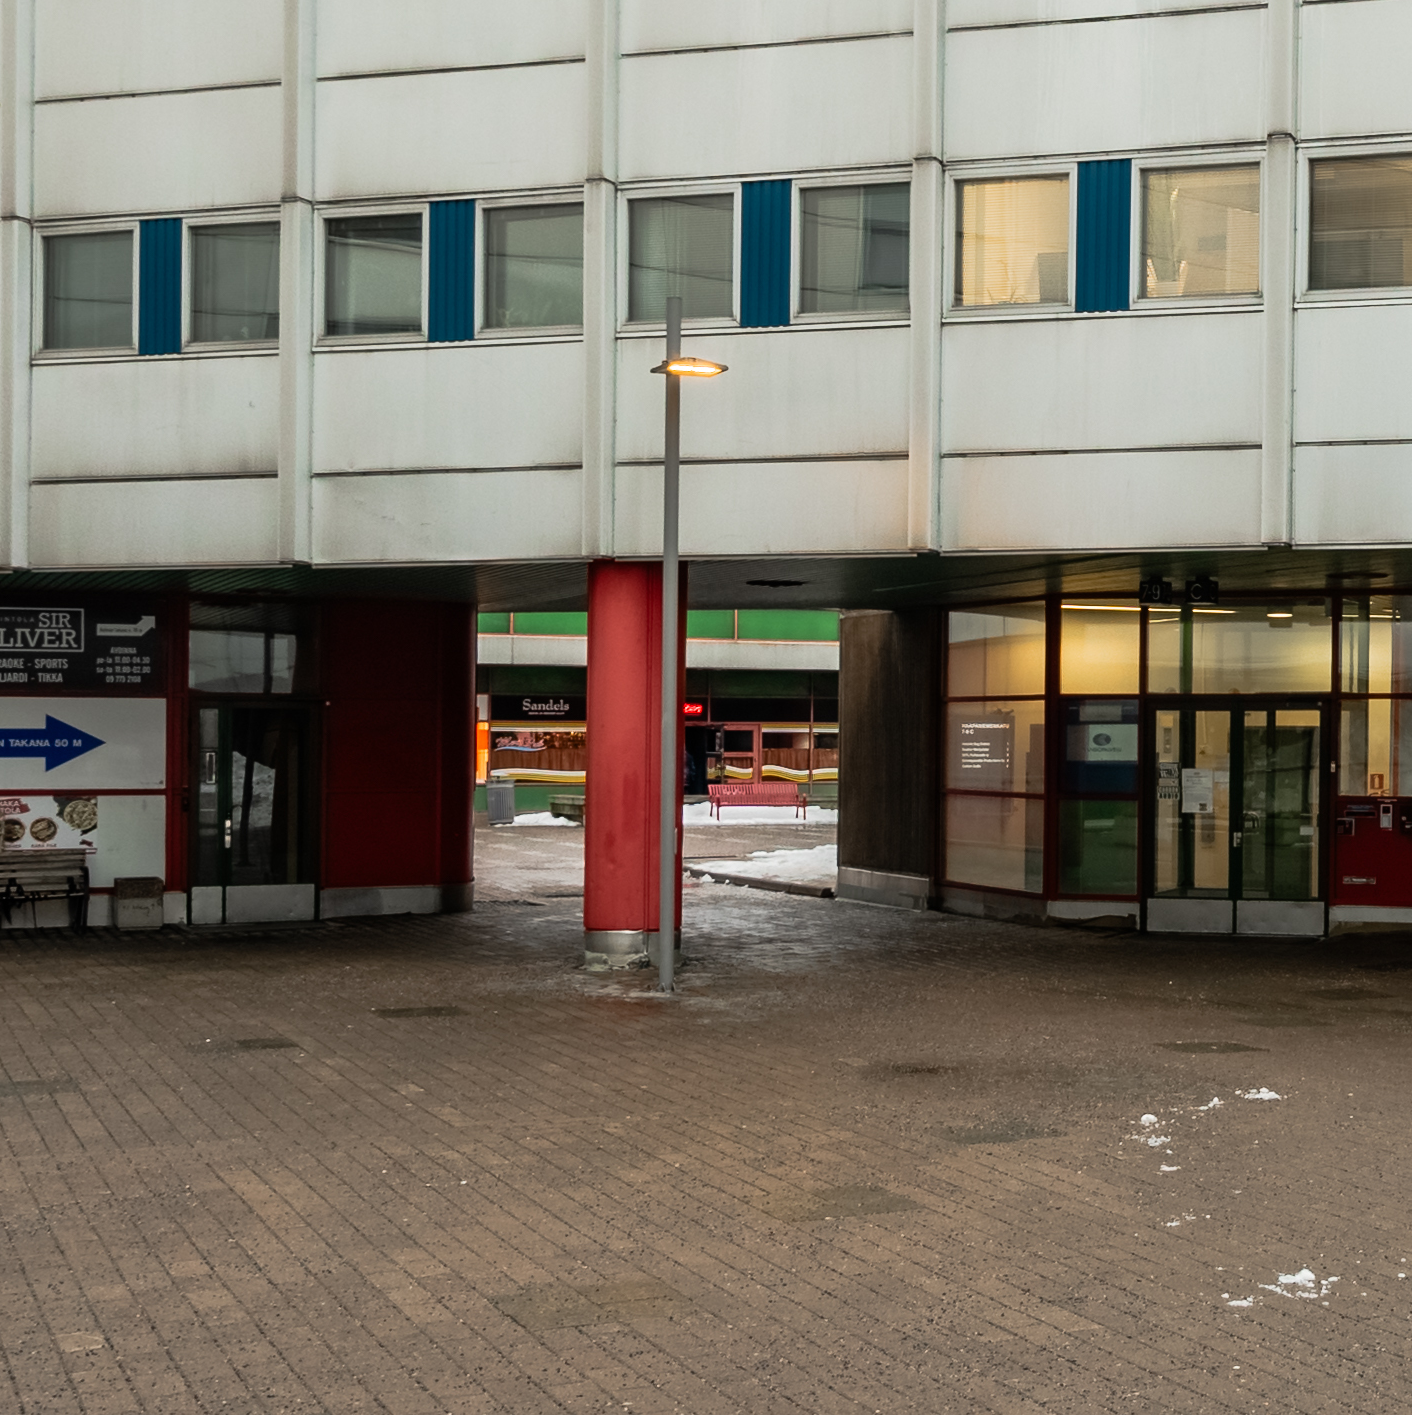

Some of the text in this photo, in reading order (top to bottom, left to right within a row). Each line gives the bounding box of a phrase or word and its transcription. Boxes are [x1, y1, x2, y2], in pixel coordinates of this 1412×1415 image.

[1141, 584, 1161, 600] 7-9
[1190, 583, 1203, 600] C
[38, 612, 72, 628] SIR
[34, 658, 69, 669] SPORTS
[37, 672, 64, 683] TIKKA
[522, 698, 570, 711] Sandels
[9, 739, 50, 748] TAKANA
[54, 739, 69, 748] 50
[72, 739, 82, 748] M
